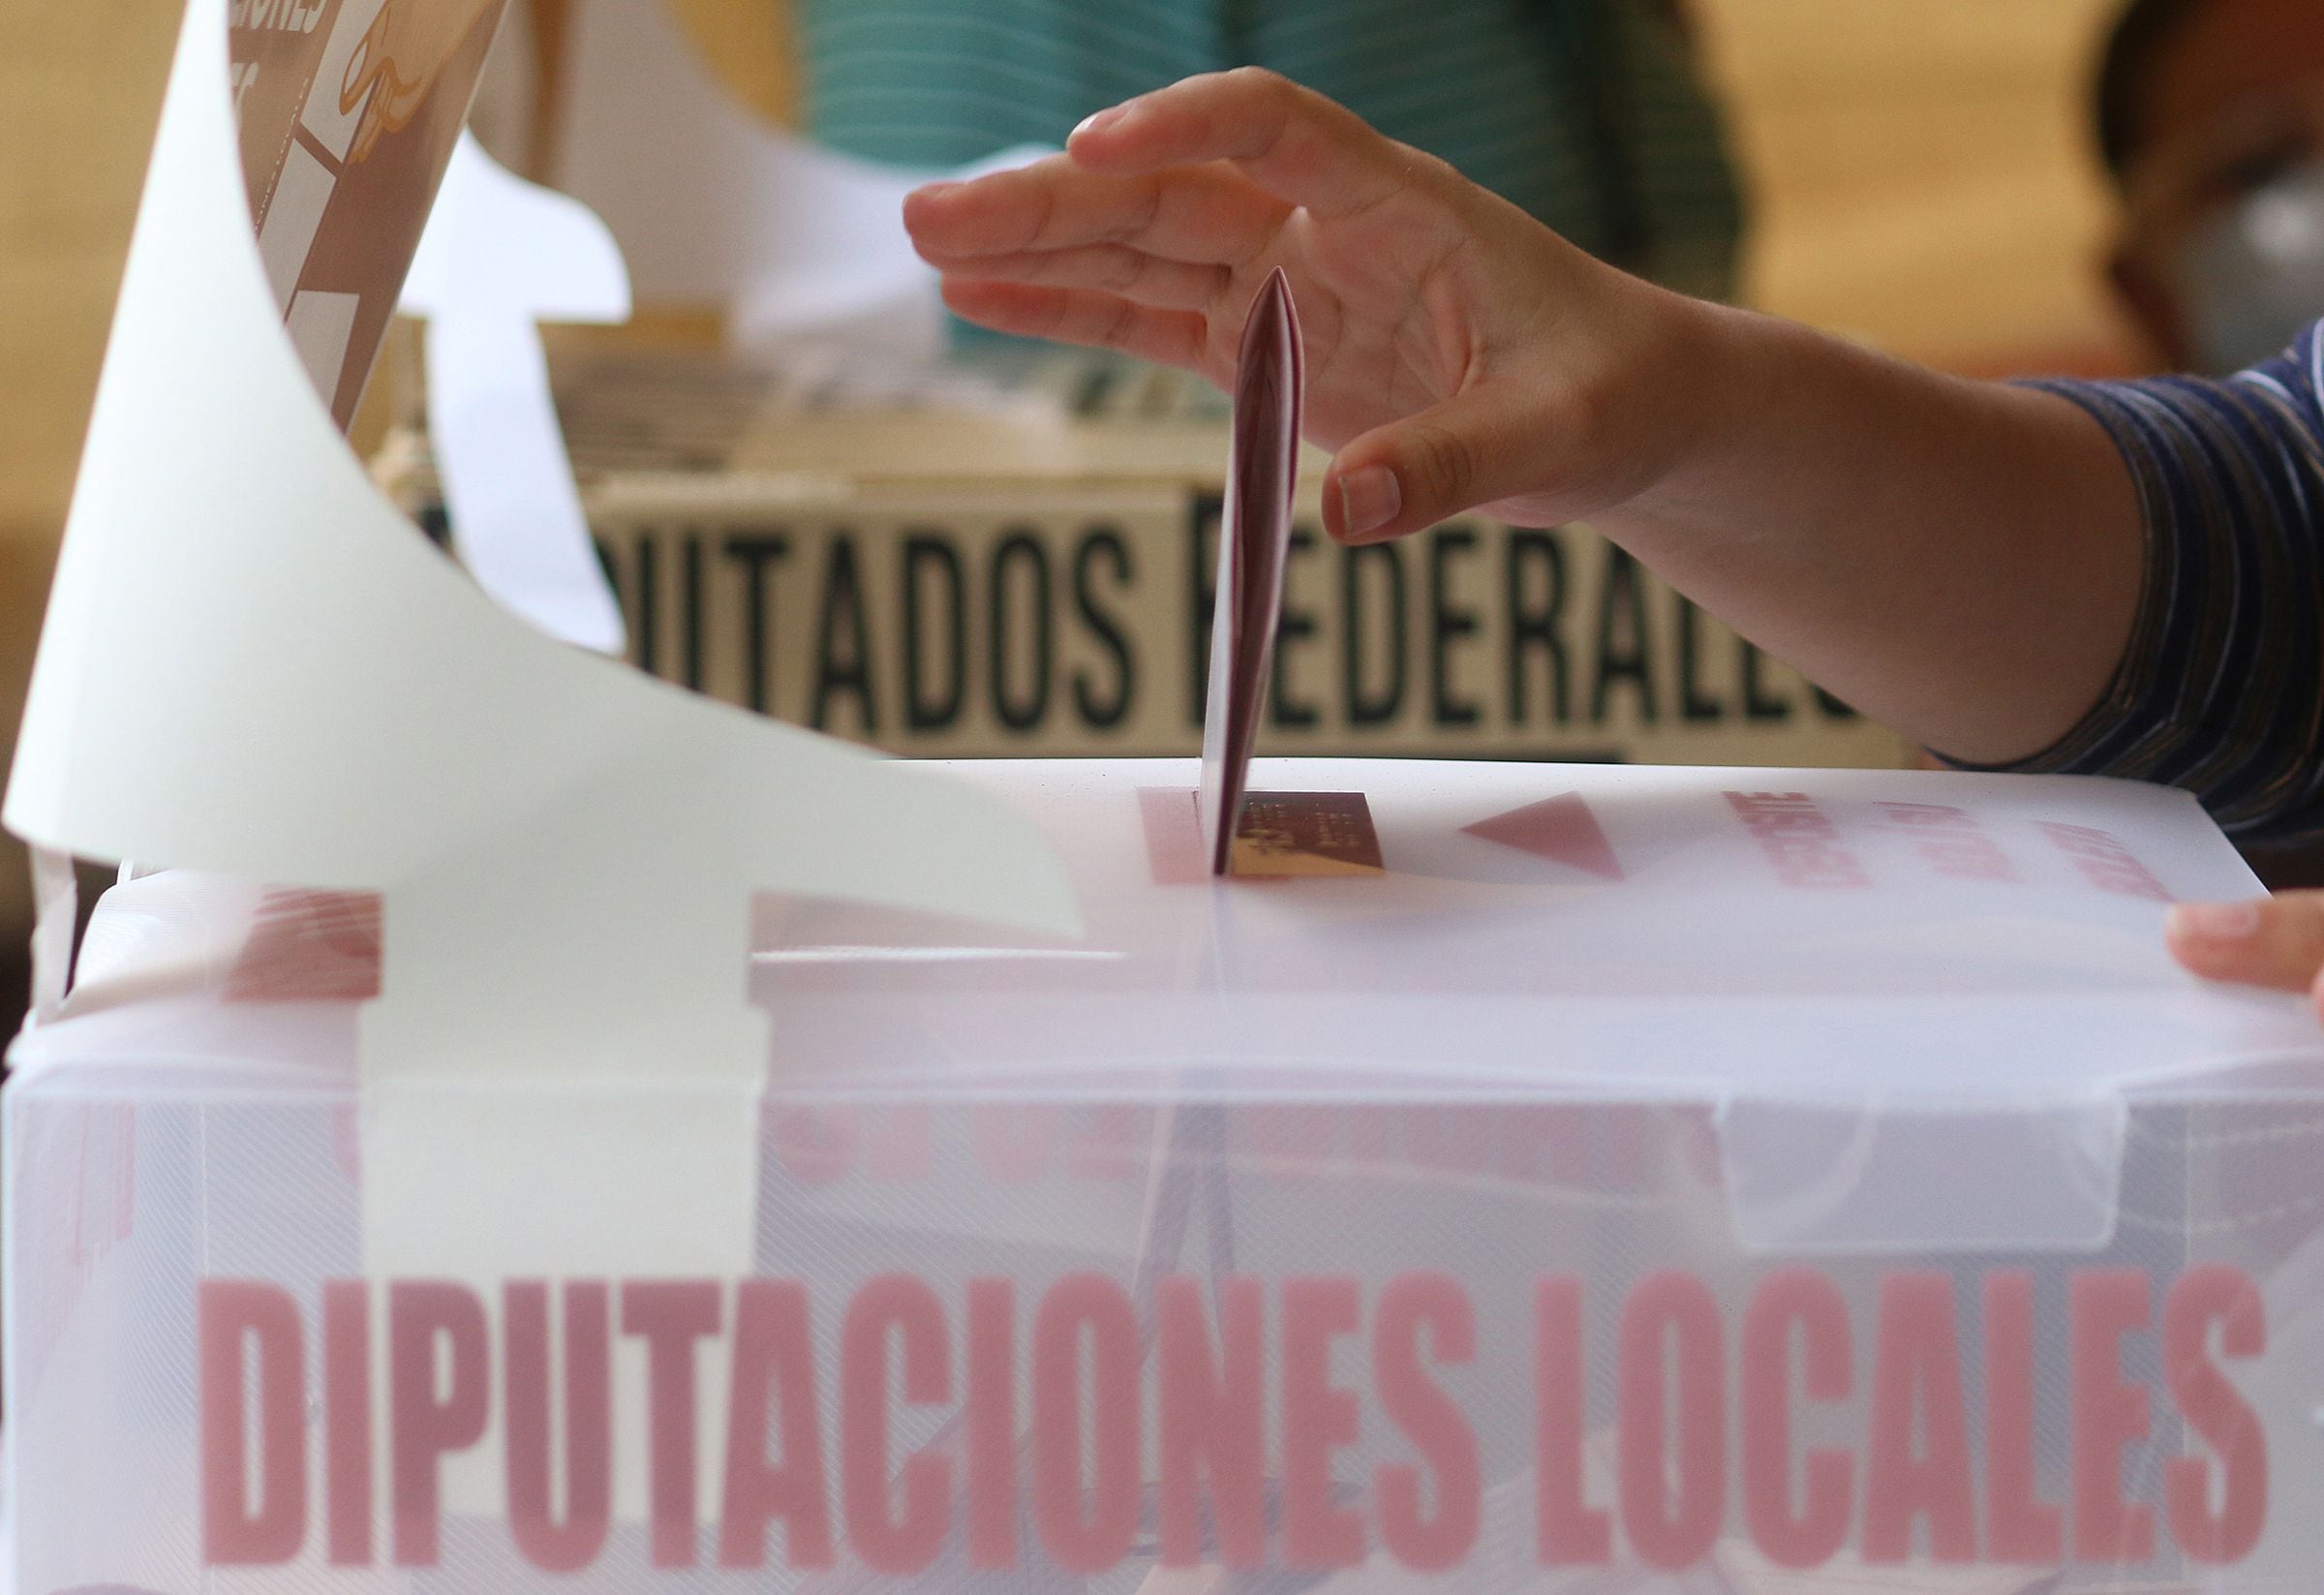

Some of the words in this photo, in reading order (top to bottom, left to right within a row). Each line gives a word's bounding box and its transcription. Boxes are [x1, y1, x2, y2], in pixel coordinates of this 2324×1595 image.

[418, 504, 1139, 734] UTADOS
[1187, 490, 1857, 730] FEDERAL
[199, 1271, 1482, 1576] DIPUTACIONES
[1534, 1262, 2269, 1571] LOCALES
